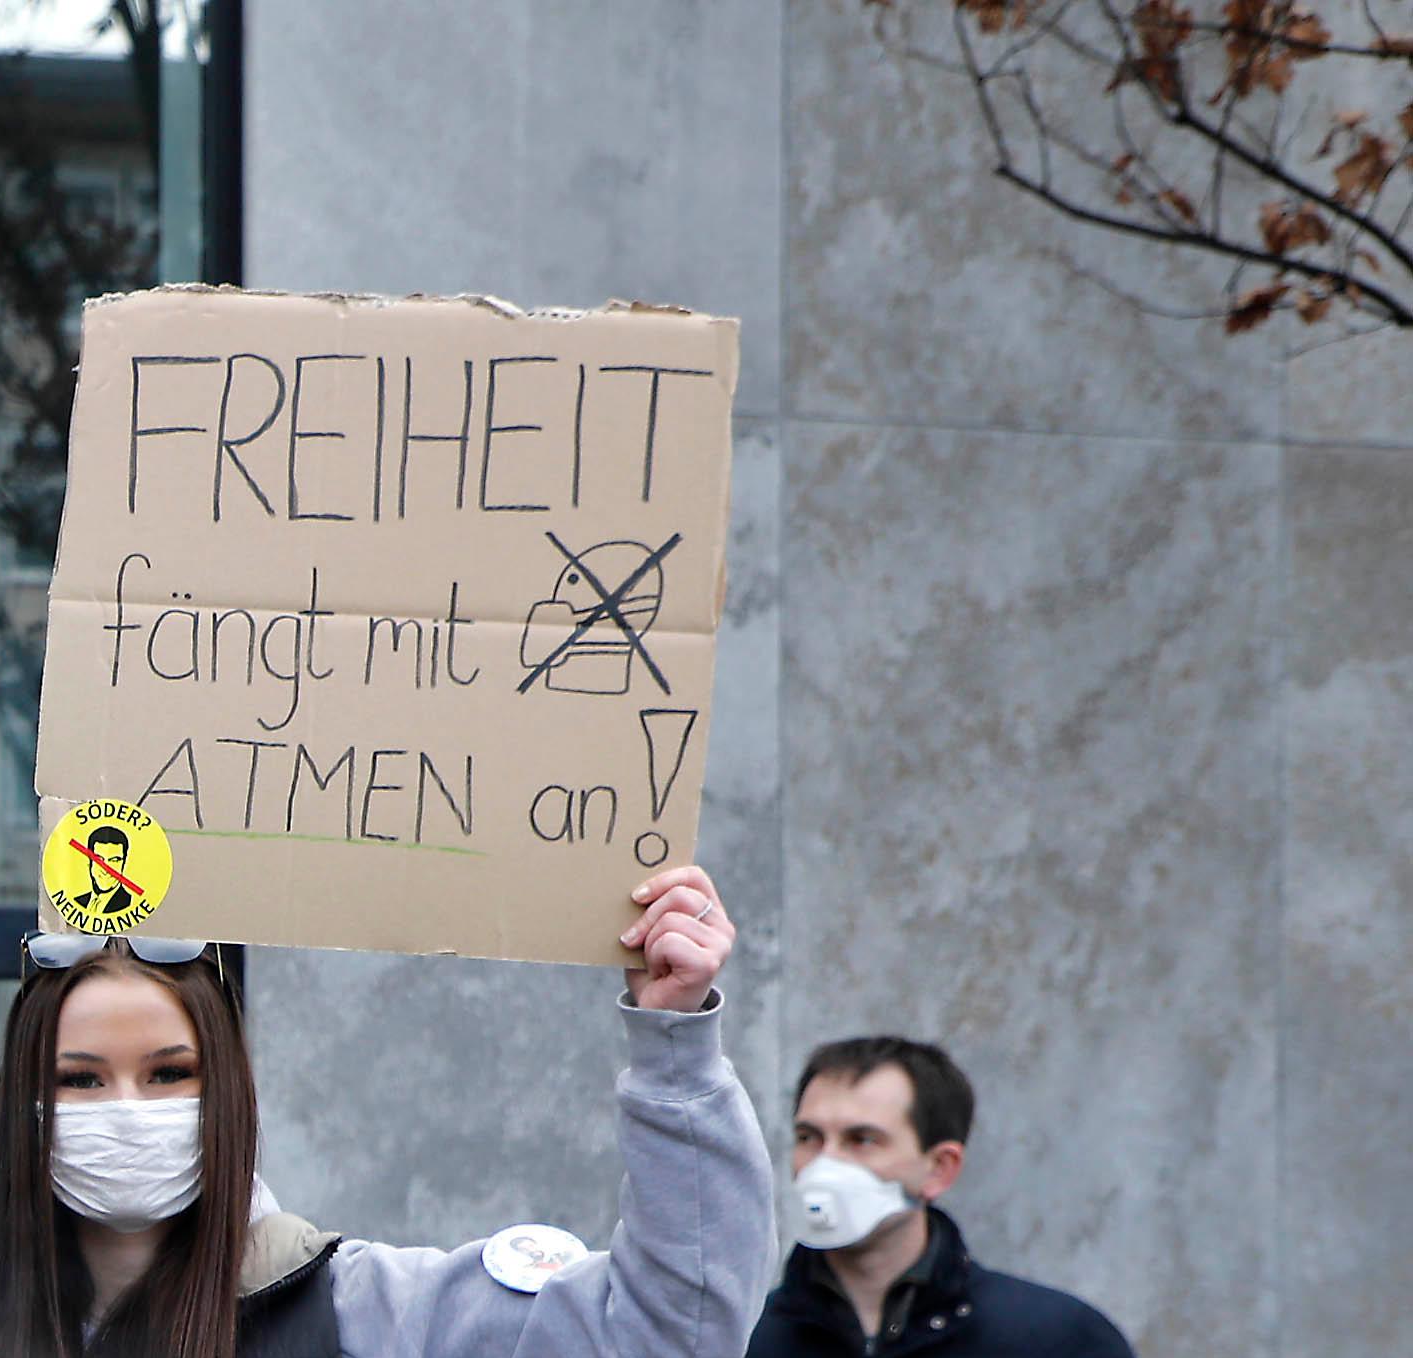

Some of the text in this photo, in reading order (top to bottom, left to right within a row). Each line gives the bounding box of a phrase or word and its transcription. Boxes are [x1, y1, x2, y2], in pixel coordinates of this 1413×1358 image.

[127, 352, 715, 522] FREIHEIT
[103, 553, 480, 731] fängt mit
[75, 799, 152, 831] SÖDER?
[134, 736, 475, 843] ATMEN
[51, 889, 155, 934] NEIN DANKE
